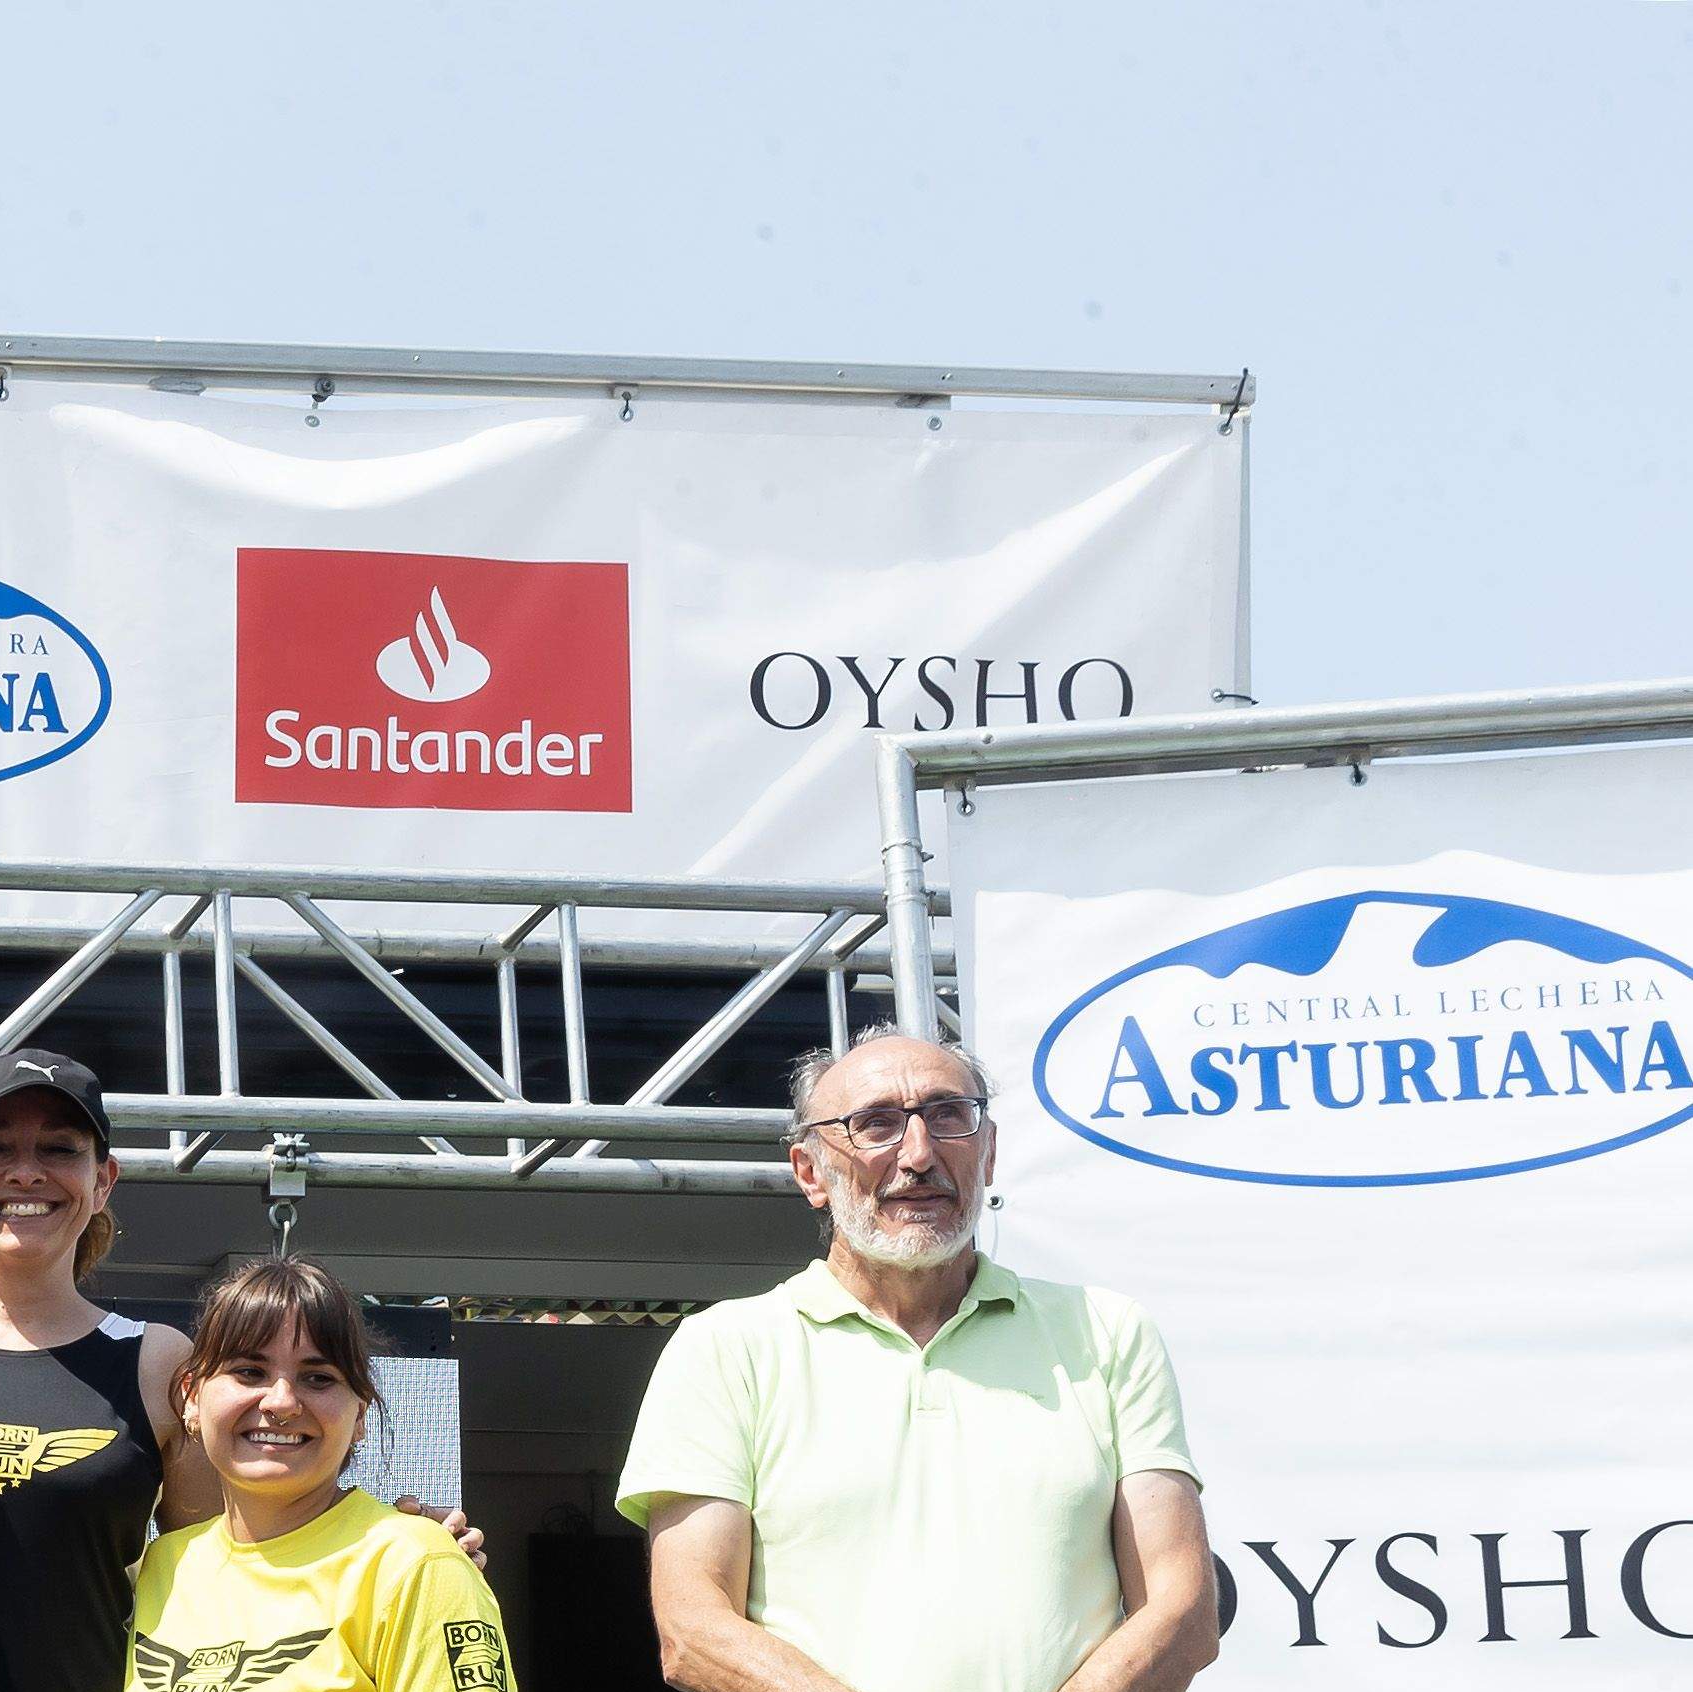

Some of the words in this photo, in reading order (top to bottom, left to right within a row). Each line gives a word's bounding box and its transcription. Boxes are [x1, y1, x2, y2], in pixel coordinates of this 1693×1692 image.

[749, 650, 1134, 734] OYSHO
[265, 709, 604, 777] Santander
[1193, 992, 1413, 1028] CENTRAL
[1438, 979, 1666, 1015] LECHERA
[1091, 1014, 1693, 1120] ASTURIANA
[192, 1645, 237, 1667] BORN
[450, 1624, 499, 1647] BORN
[458, 1667, 504, 1690] RUN
